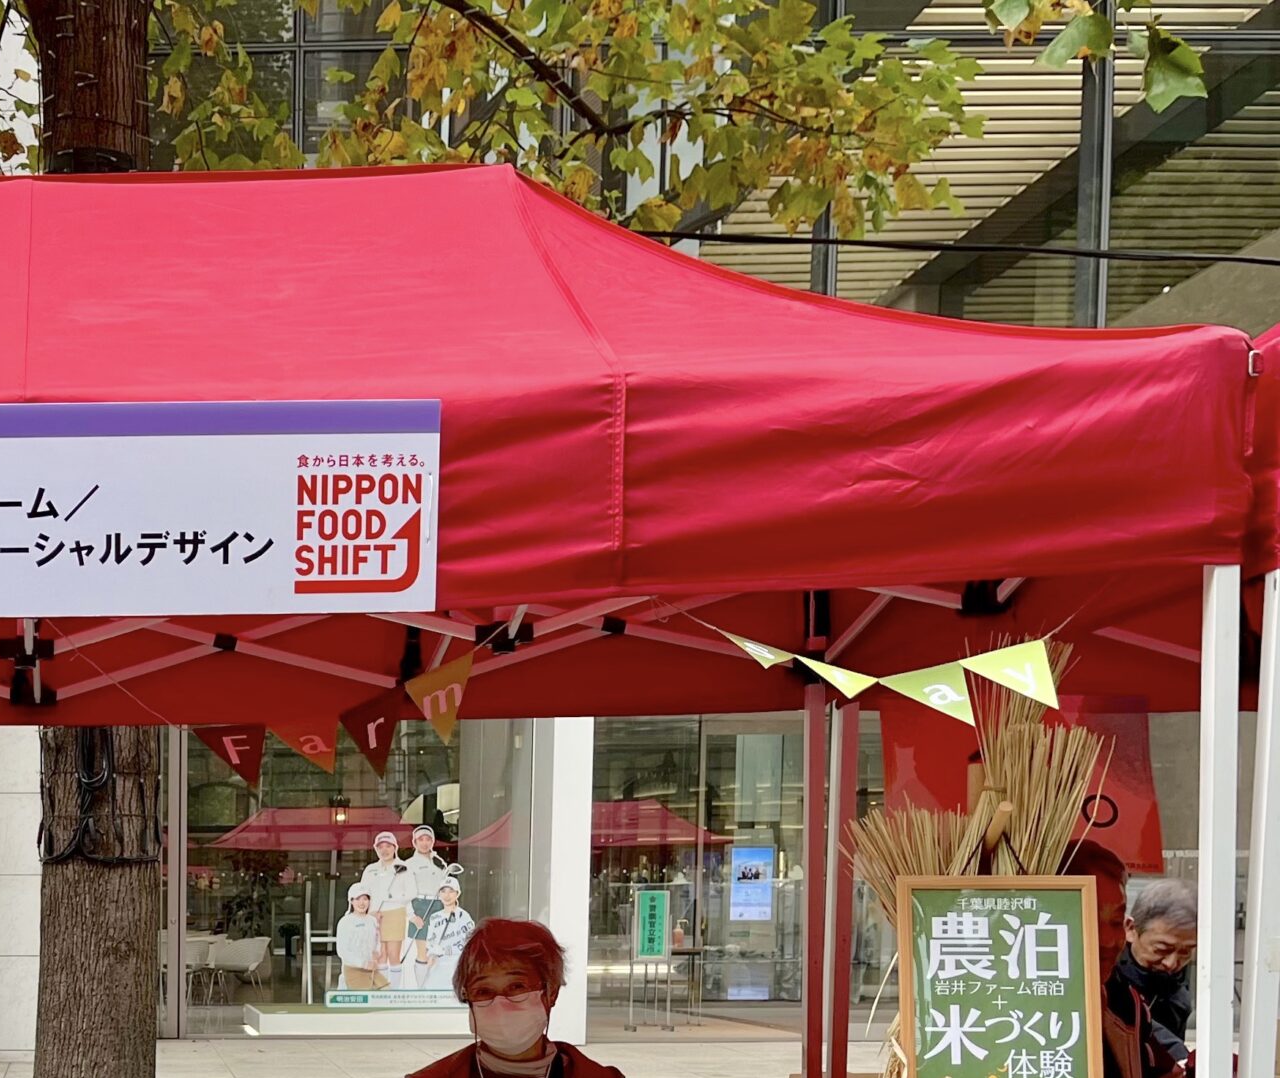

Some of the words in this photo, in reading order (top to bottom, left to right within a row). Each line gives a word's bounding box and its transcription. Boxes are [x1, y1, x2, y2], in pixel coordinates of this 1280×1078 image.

[297, 454, 426, 468] 食から日本を考える。
[297, 473, 422, 505] NIPPON
[297, 509, 387, 541] FOOD
[295, 544, 396, 576] SHIFT
[957, 898, 1037, 911] 千葉県睦沢町
[926, 911, 1070, 980] 農泊
[934, 980, 1065, 996] 岩井ファーム宿泊
[923, 1004, 1081, 1065] 米づくり
